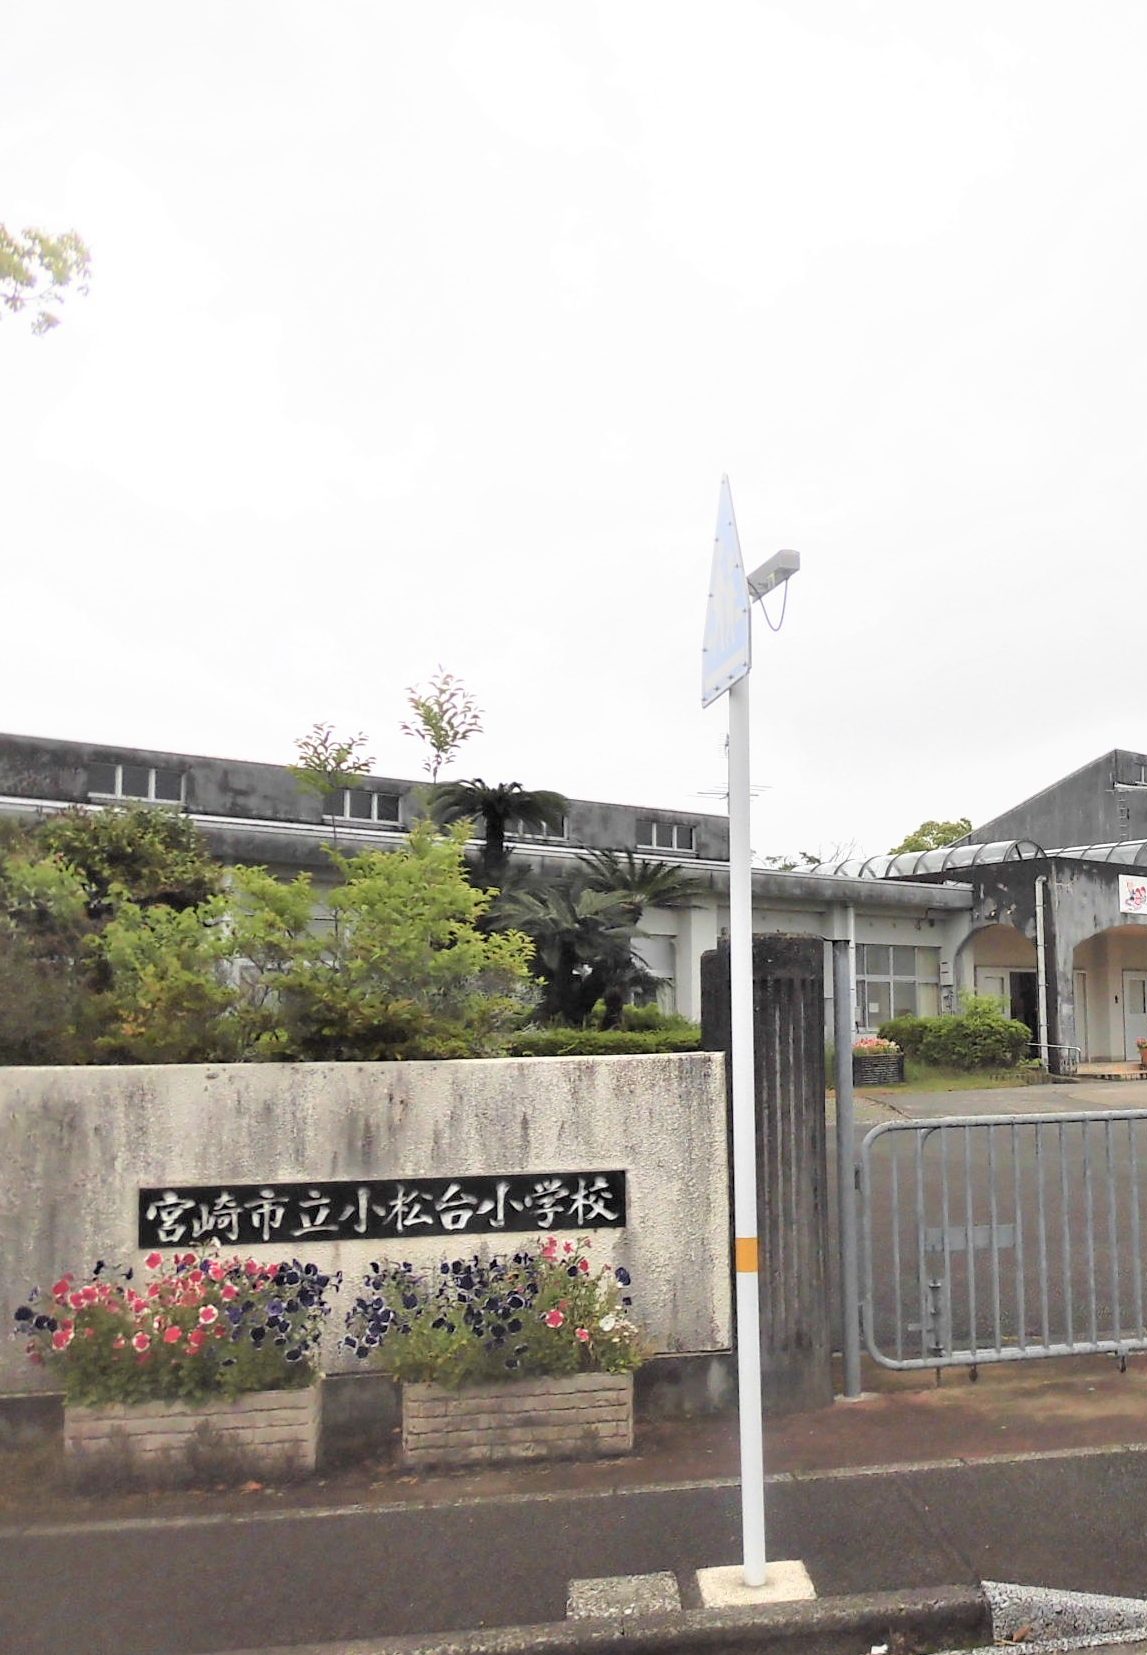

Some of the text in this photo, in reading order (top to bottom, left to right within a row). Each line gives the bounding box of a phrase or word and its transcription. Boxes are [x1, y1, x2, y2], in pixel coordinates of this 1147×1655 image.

[145, 1176, 619, 1243] 宮崎市立小松台小学校
